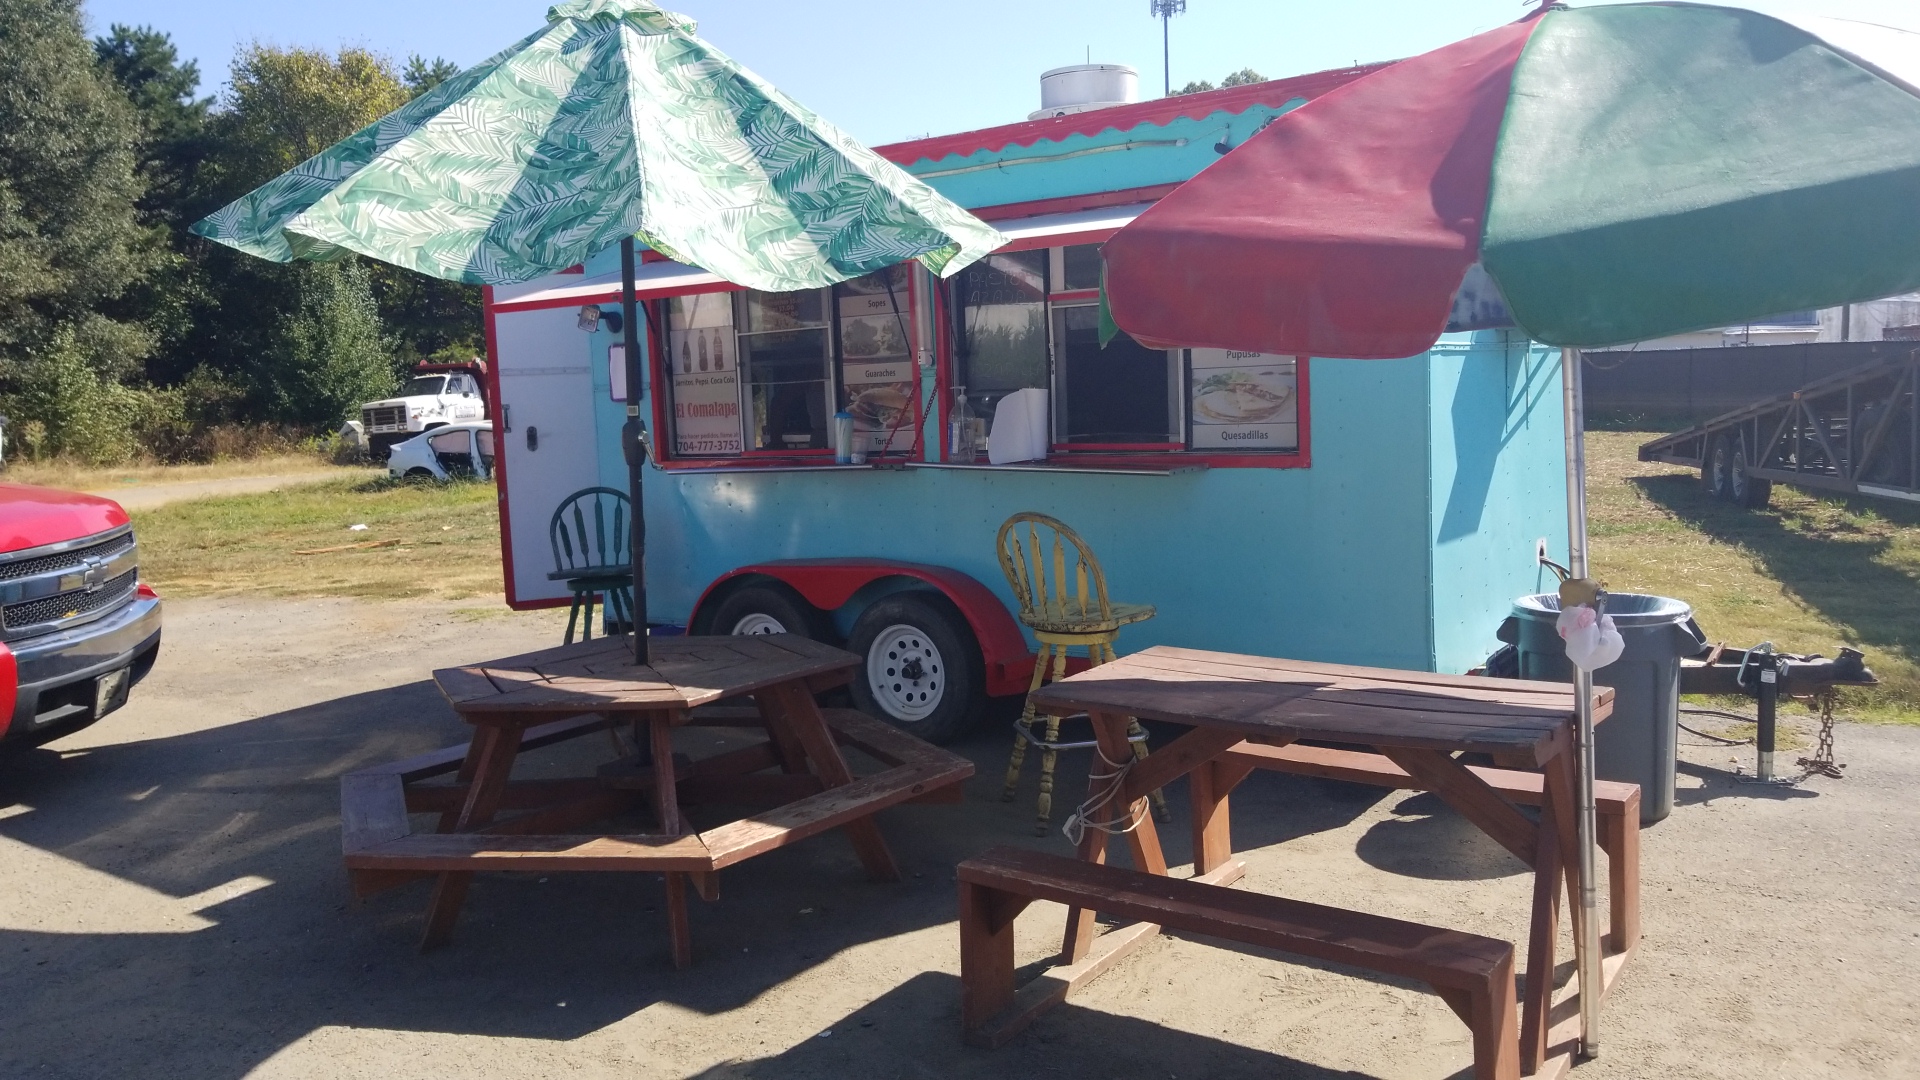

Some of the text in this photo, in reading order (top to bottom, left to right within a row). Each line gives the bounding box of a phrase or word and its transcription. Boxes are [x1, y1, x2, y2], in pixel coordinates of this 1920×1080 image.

[868, 299, 886, 309] Sopes
[1226, 350, 1261, 360] Pupusas
[865, 369, 896, 378] Guaraches
[676, 402, 737, 418] El Comalapa
[1221, 430, 1269, 441] Quesadillas
[678, 440, 740, 451] 704-777-3752
[874, 437, 893, 446] Torts
